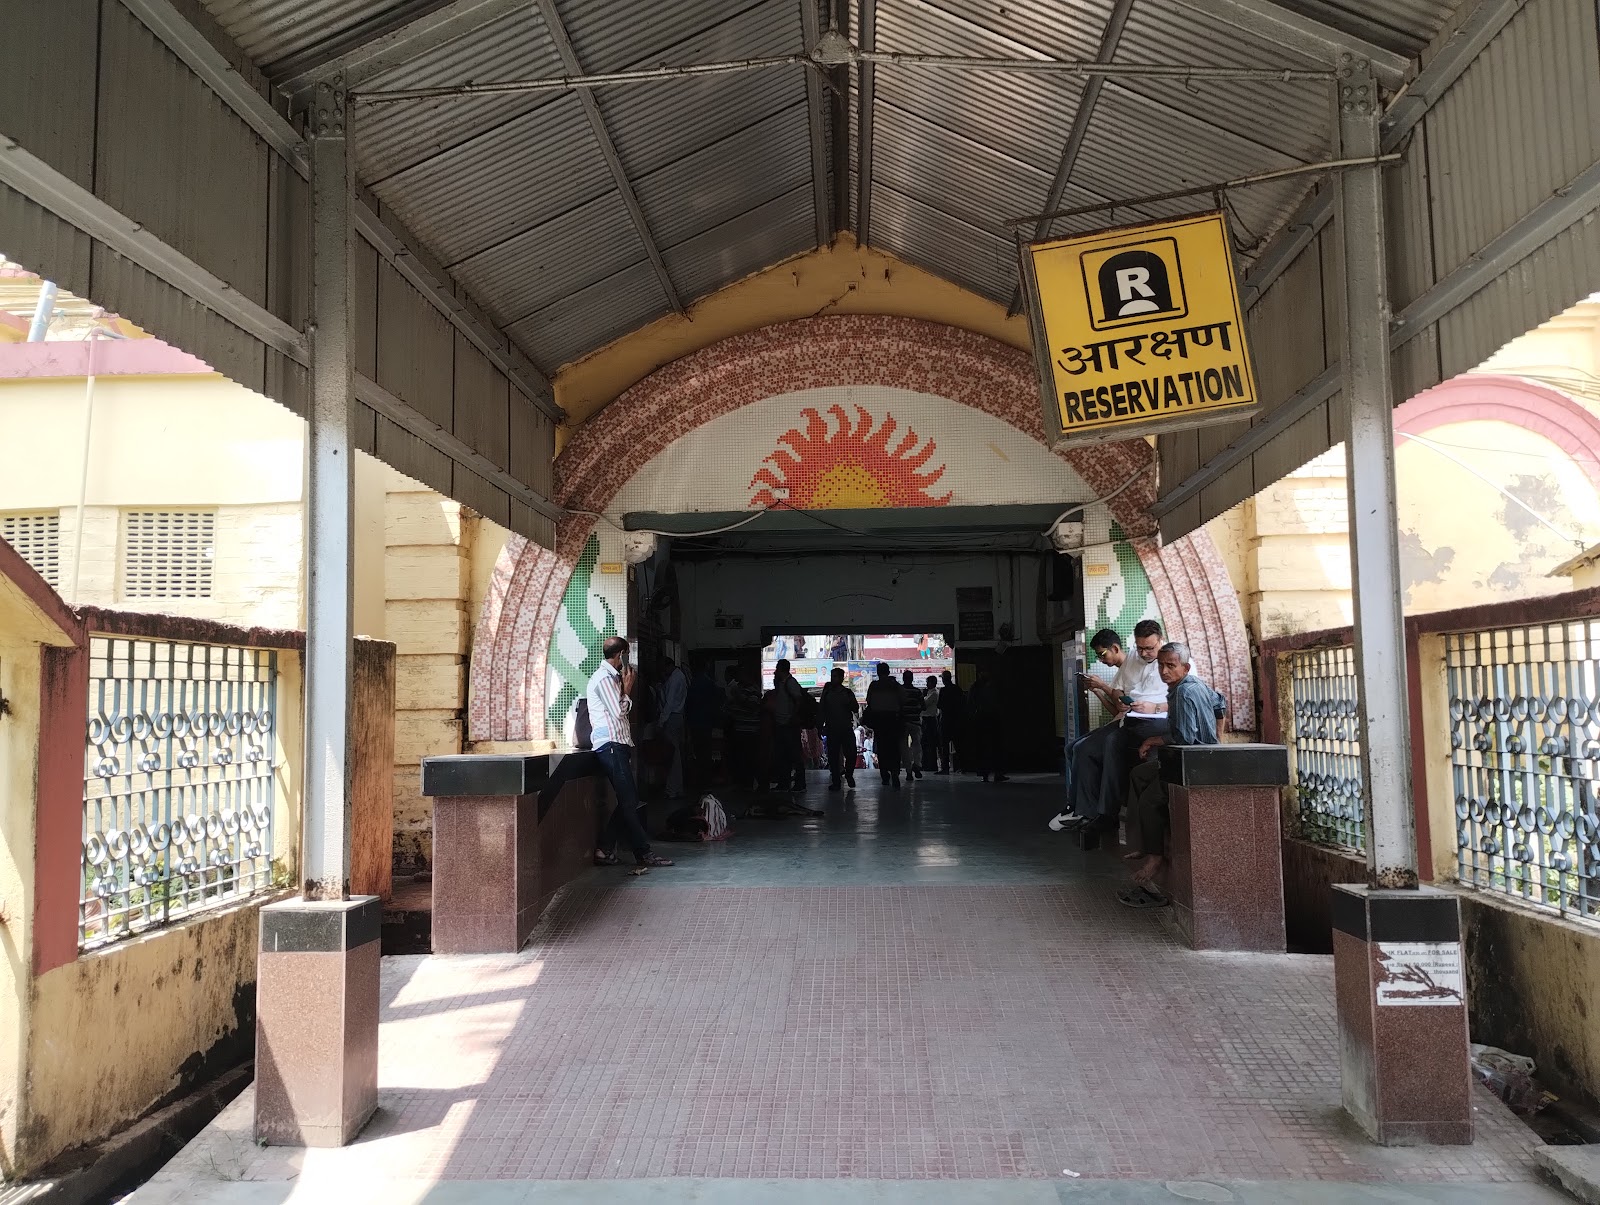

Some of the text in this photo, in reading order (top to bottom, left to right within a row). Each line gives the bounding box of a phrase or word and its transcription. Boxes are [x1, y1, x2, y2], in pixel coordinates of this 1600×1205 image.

[1116, 266, 1156, 301] R
[1058, 321, 1231, 375] आरक्षण
[1064, 364, 1244, 424] RESERVATION
